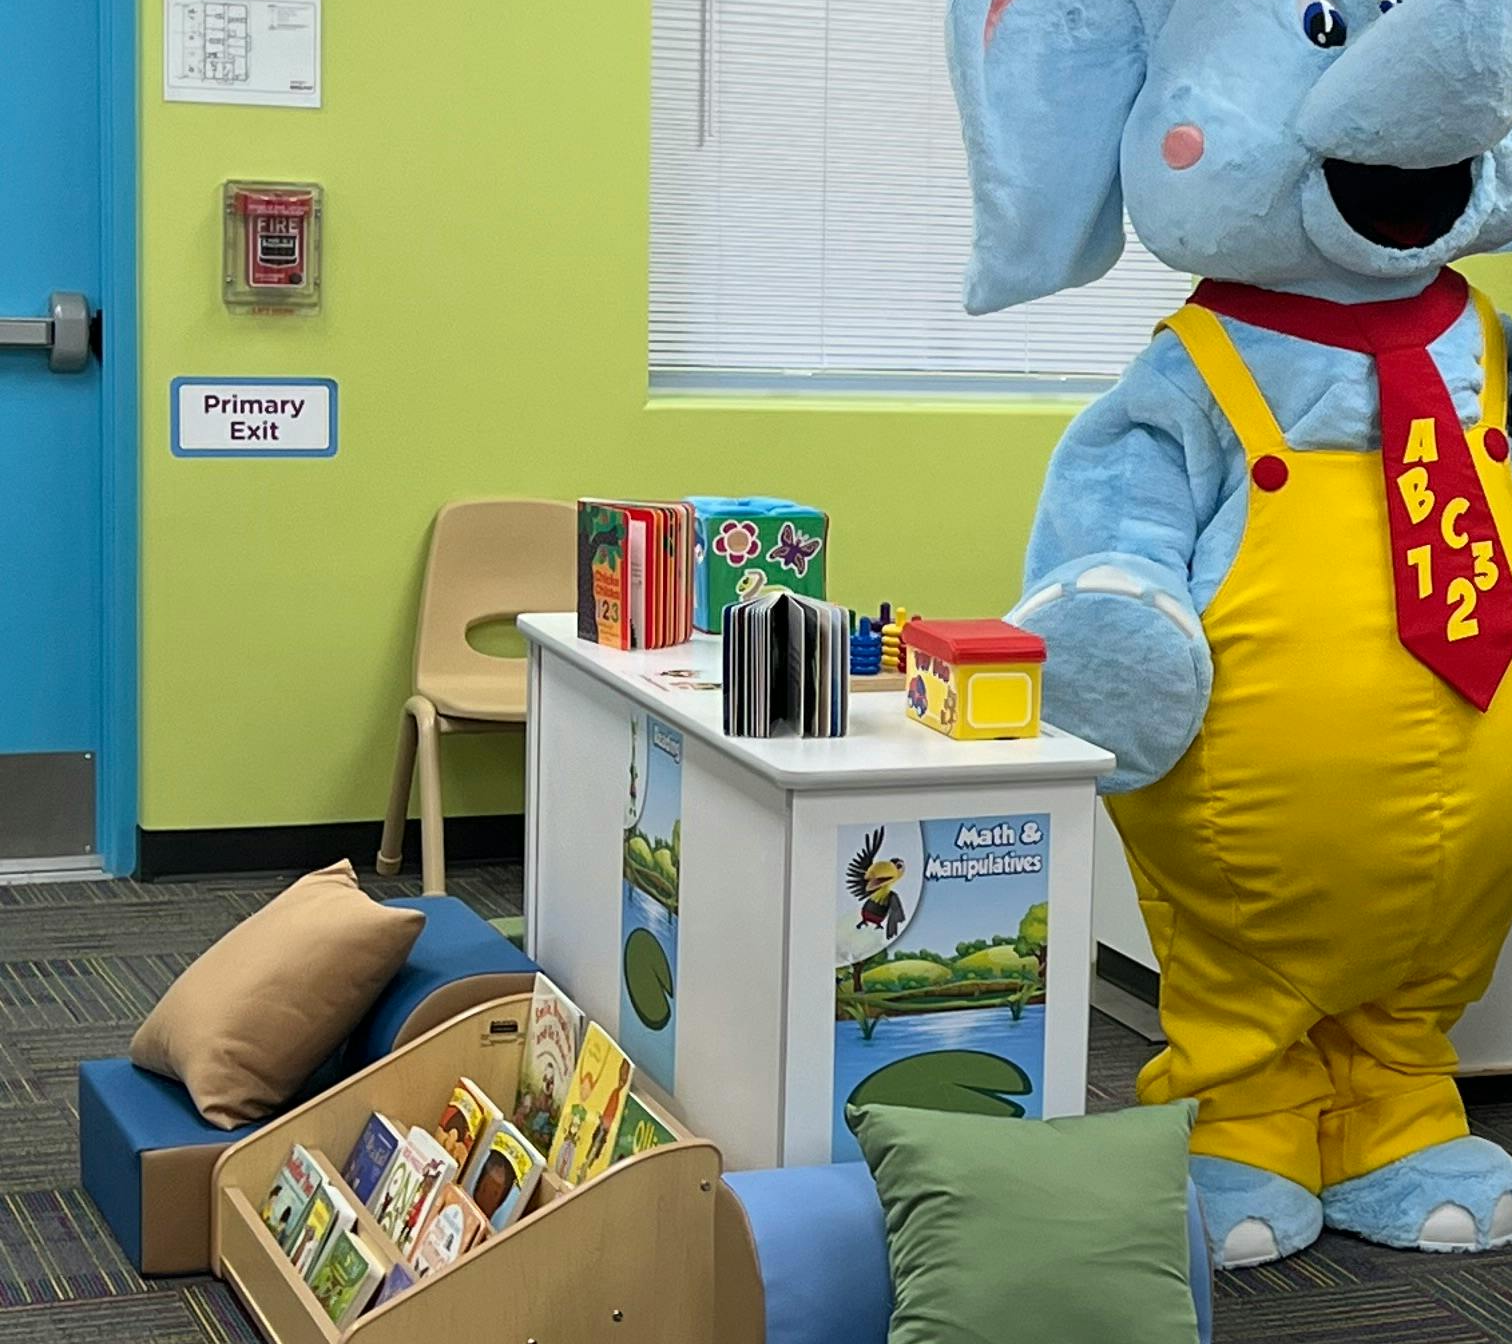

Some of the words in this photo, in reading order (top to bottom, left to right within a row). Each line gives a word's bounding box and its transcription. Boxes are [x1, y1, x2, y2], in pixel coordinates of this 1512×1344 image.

[257, 217, 299, 234] FIRE
[204, 394, 305, 418] Primary
[230, 421, 279, 441] Exit
[1403, 418, 1438, 463] A
[1396, 467, 1435, 525] B
[1441, 497, 1470, 549] C
[1407, 544, 1432, 599] 1
[1447, 576, 1479, 642] 2
[1471, 540, 1498, 591] 3
[955, 822, 1015, 850] Math
[1020, 821, 1043, 845] &
[924, 851, 1041, 882] Manipulatives
